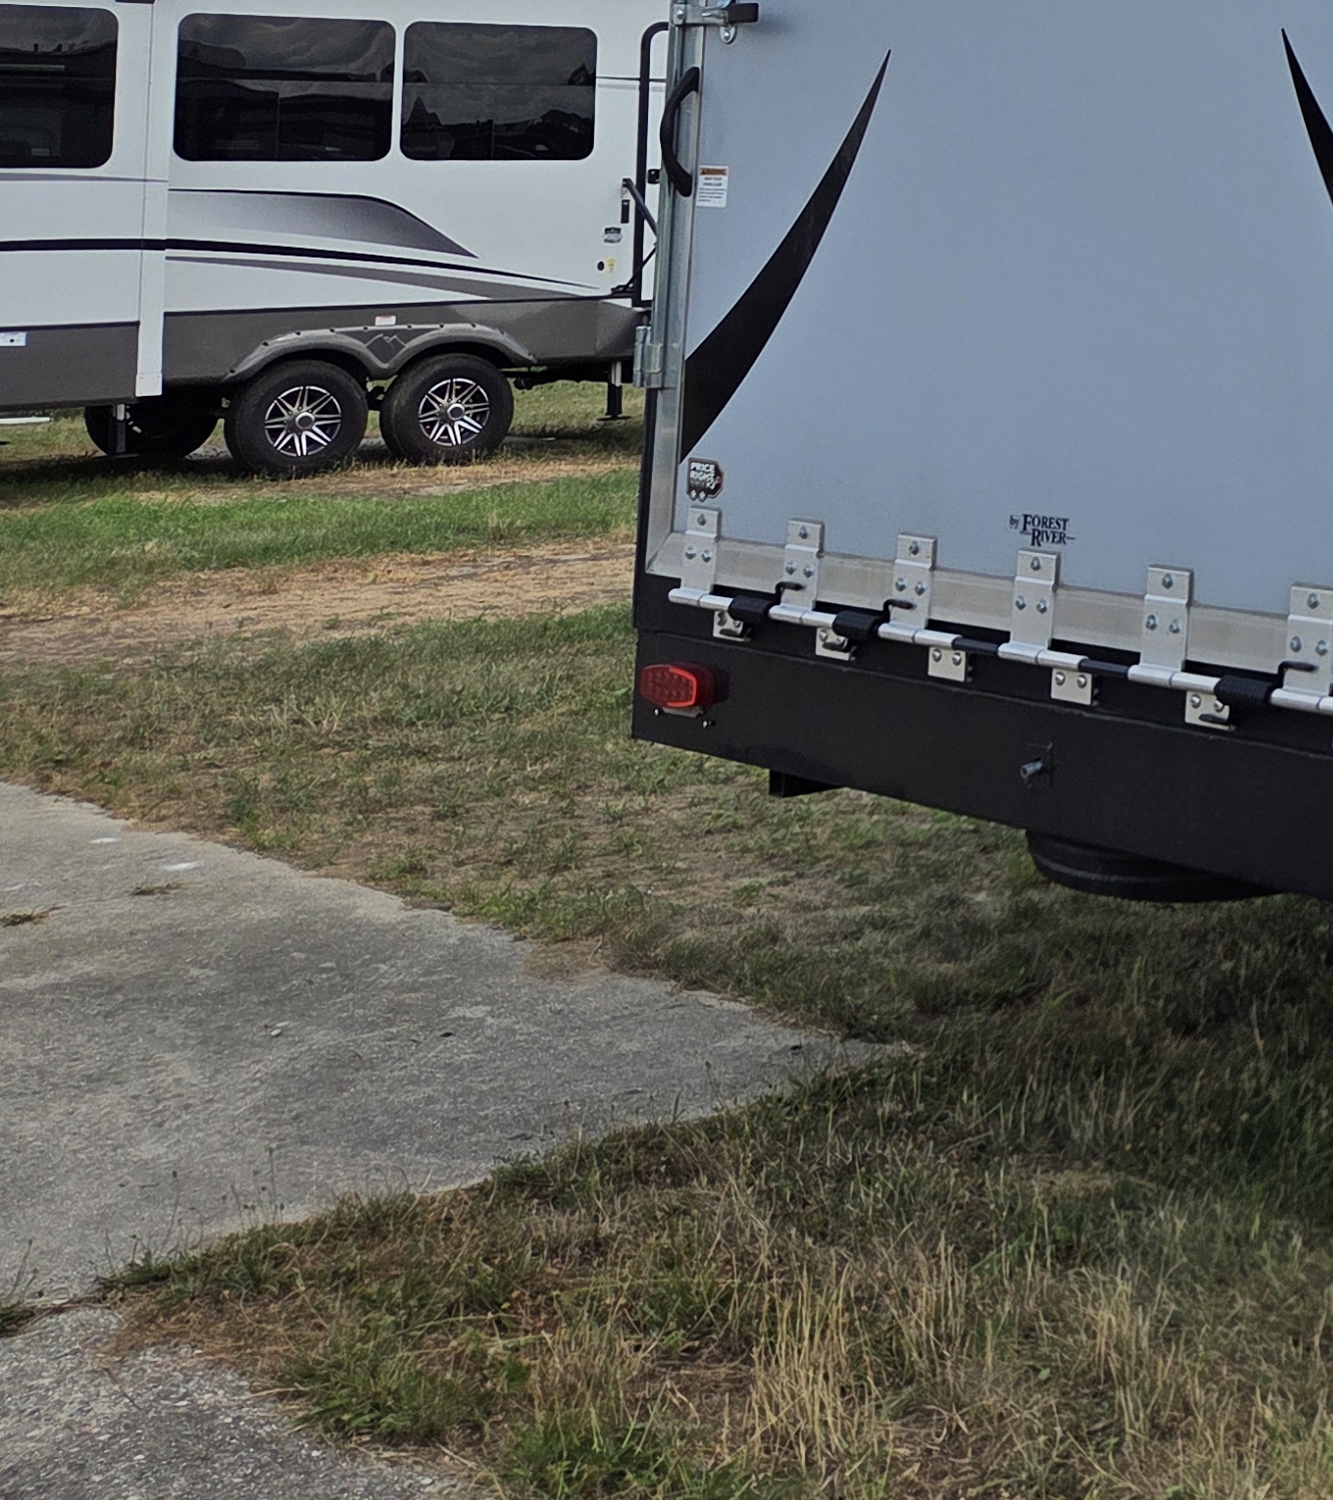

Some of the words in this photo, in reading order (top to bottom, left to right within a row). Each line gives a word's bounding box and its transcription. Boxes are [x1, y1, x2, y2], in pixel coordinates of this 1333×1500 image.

[691, 462, 715, 473] PRICE
[1022, 514, 1069, 531] FOREST
[1031, 528, 1067, 547] RIVER
